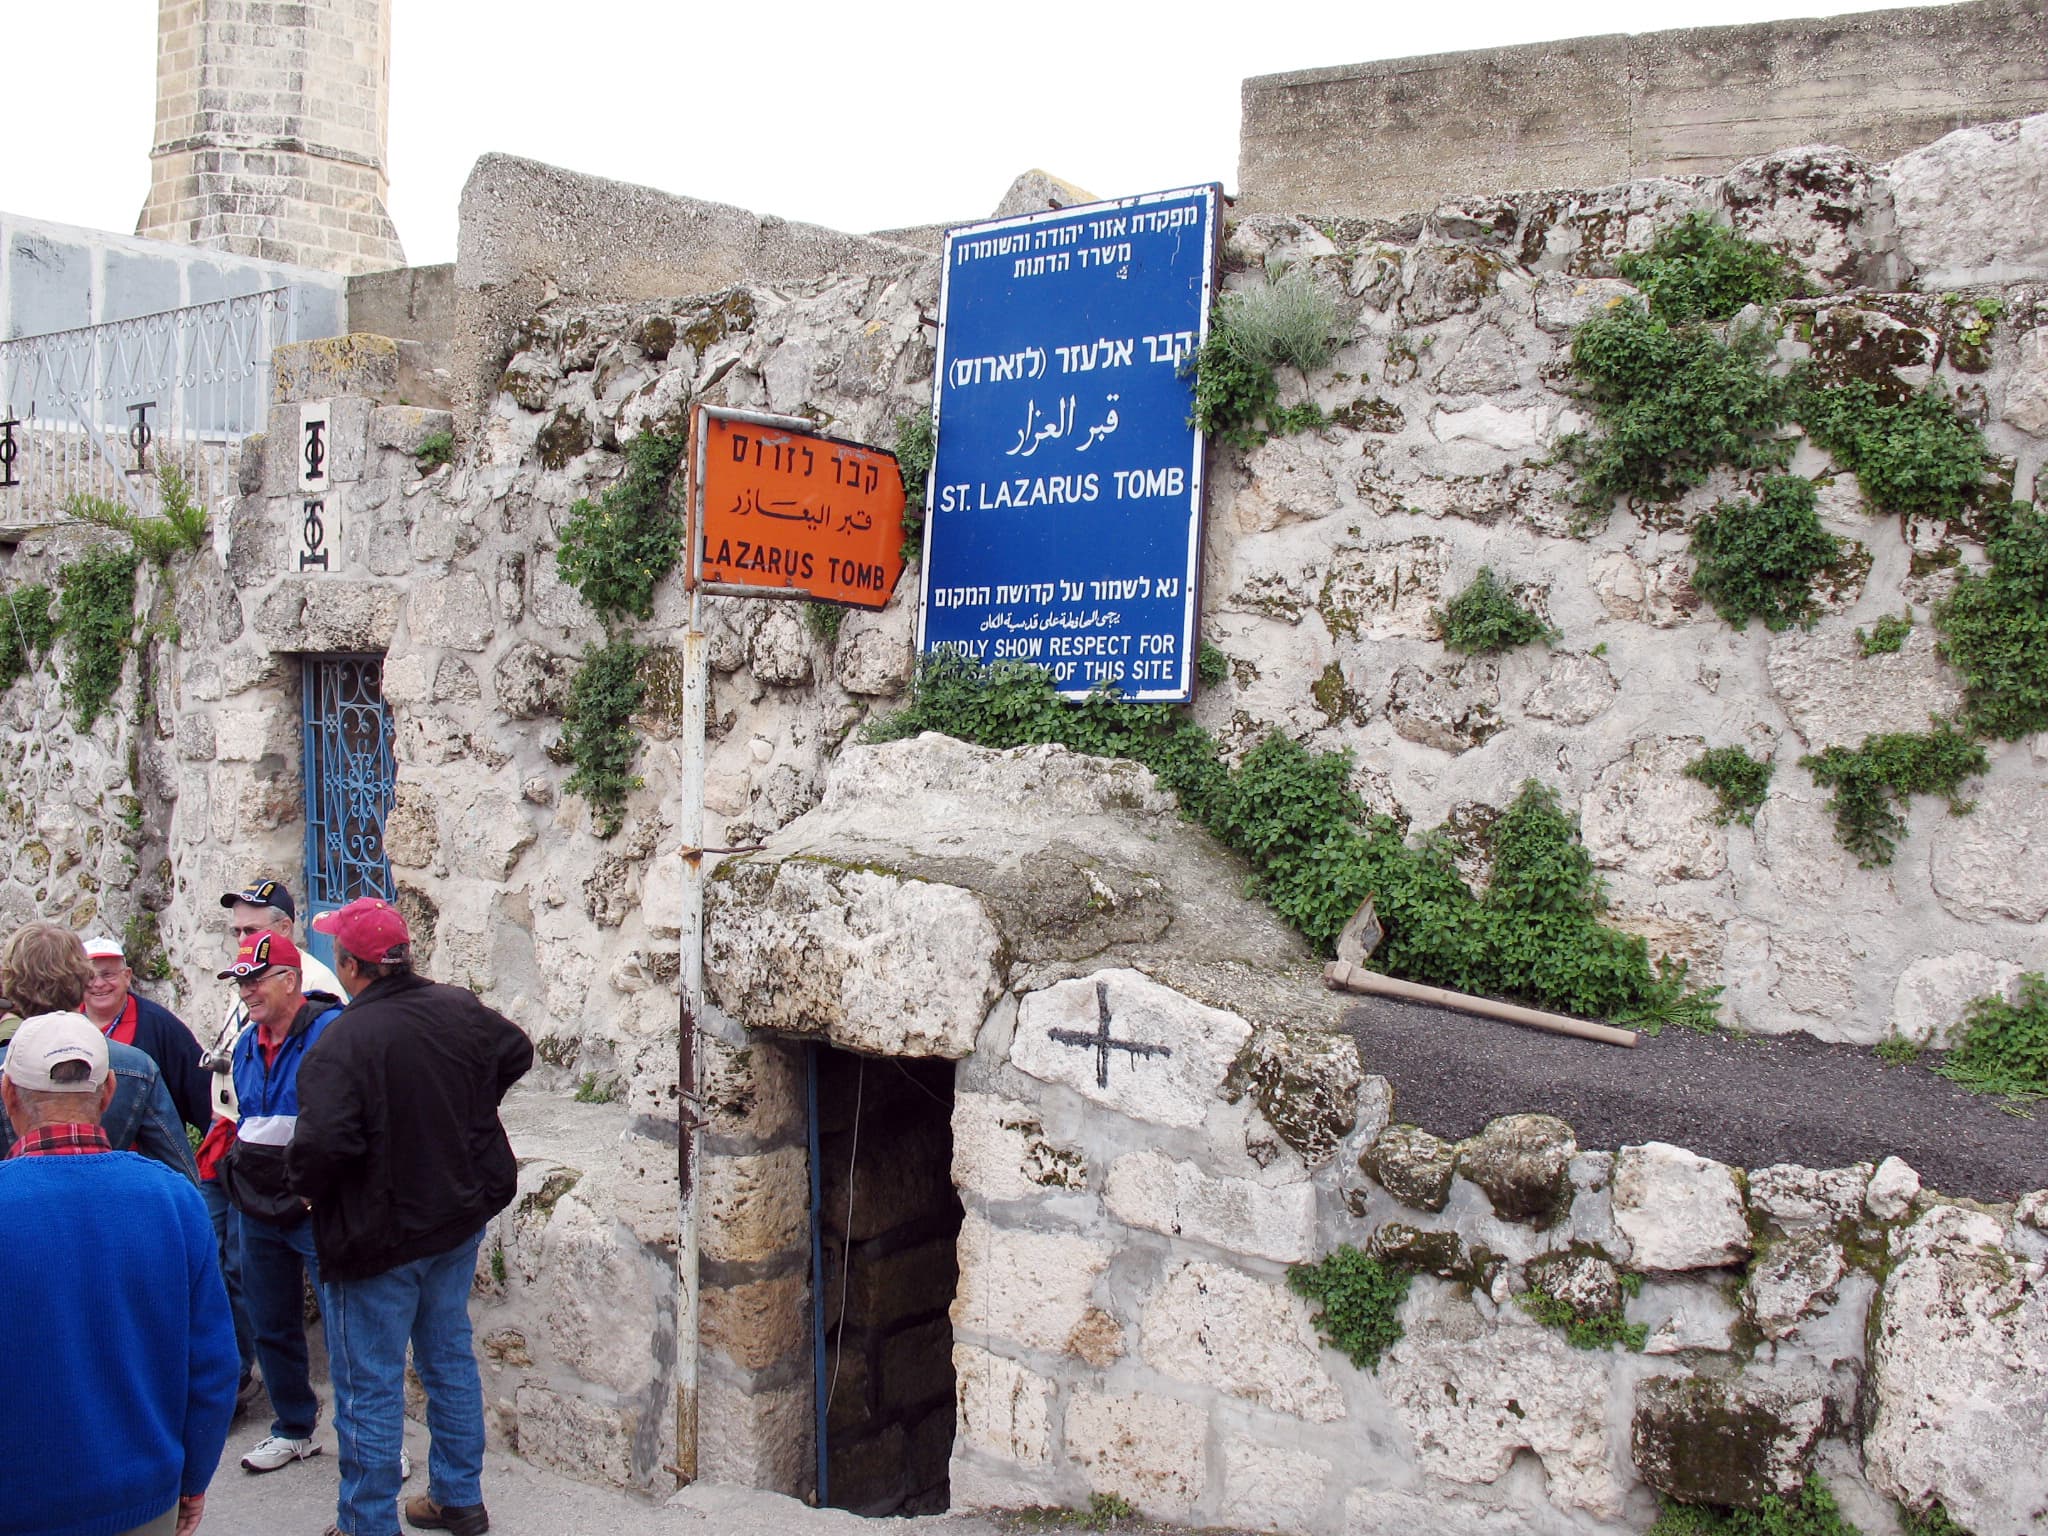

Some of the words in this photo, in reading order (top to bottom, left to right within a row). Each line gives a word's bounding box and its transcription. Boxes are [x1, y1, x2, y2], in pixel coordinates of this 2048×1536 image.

[1088, 217, 1127, 241] אזור
[1130, 206, 1198, 234] מפקדת
[957, 234, 1030, 266] והשומרון
[1034, 228, 1084, 250] יהודה
[1013, 252, 1070, 279] הדתות
[1077, 243, 1132, 268] משרד
[1055, 337, 1134, 375] אלעזר
[1142, 331, 1193, 368] קבר
[949, 347, 1047, 390] (לזארוס)
[1075, 393, 1120, 452] قبر
[831, 456, 879, 494] קבר
[939, 485, 971, 513] ST.
[979, 473, 1099, 510] LAZARUS
[1113, 467, 1185, 500] TOMB
[835, 510, 872, 536] قبر
[702, 535, 815, 579] LAZARUS
[828, 557, 886, 592] TOMB
[934, 586, 990, 609] המקום
[996, 581, 1055, 606] קדושת
[1060, 579, 1084, 602] על
[1090, 575, 1151, 601] לשמור
[1155, 577, 1179, 598] נא
[994, 637, 1043, 657] SHOW
[1049, 634, 1133, 656] RESPECT
[1139, 634, 1175, 654] FOR
[1054, 661, 1077, 681] OF
[1083, 660, 1125, 681] THIS
[1131, 659, 1174, 681] SITE
